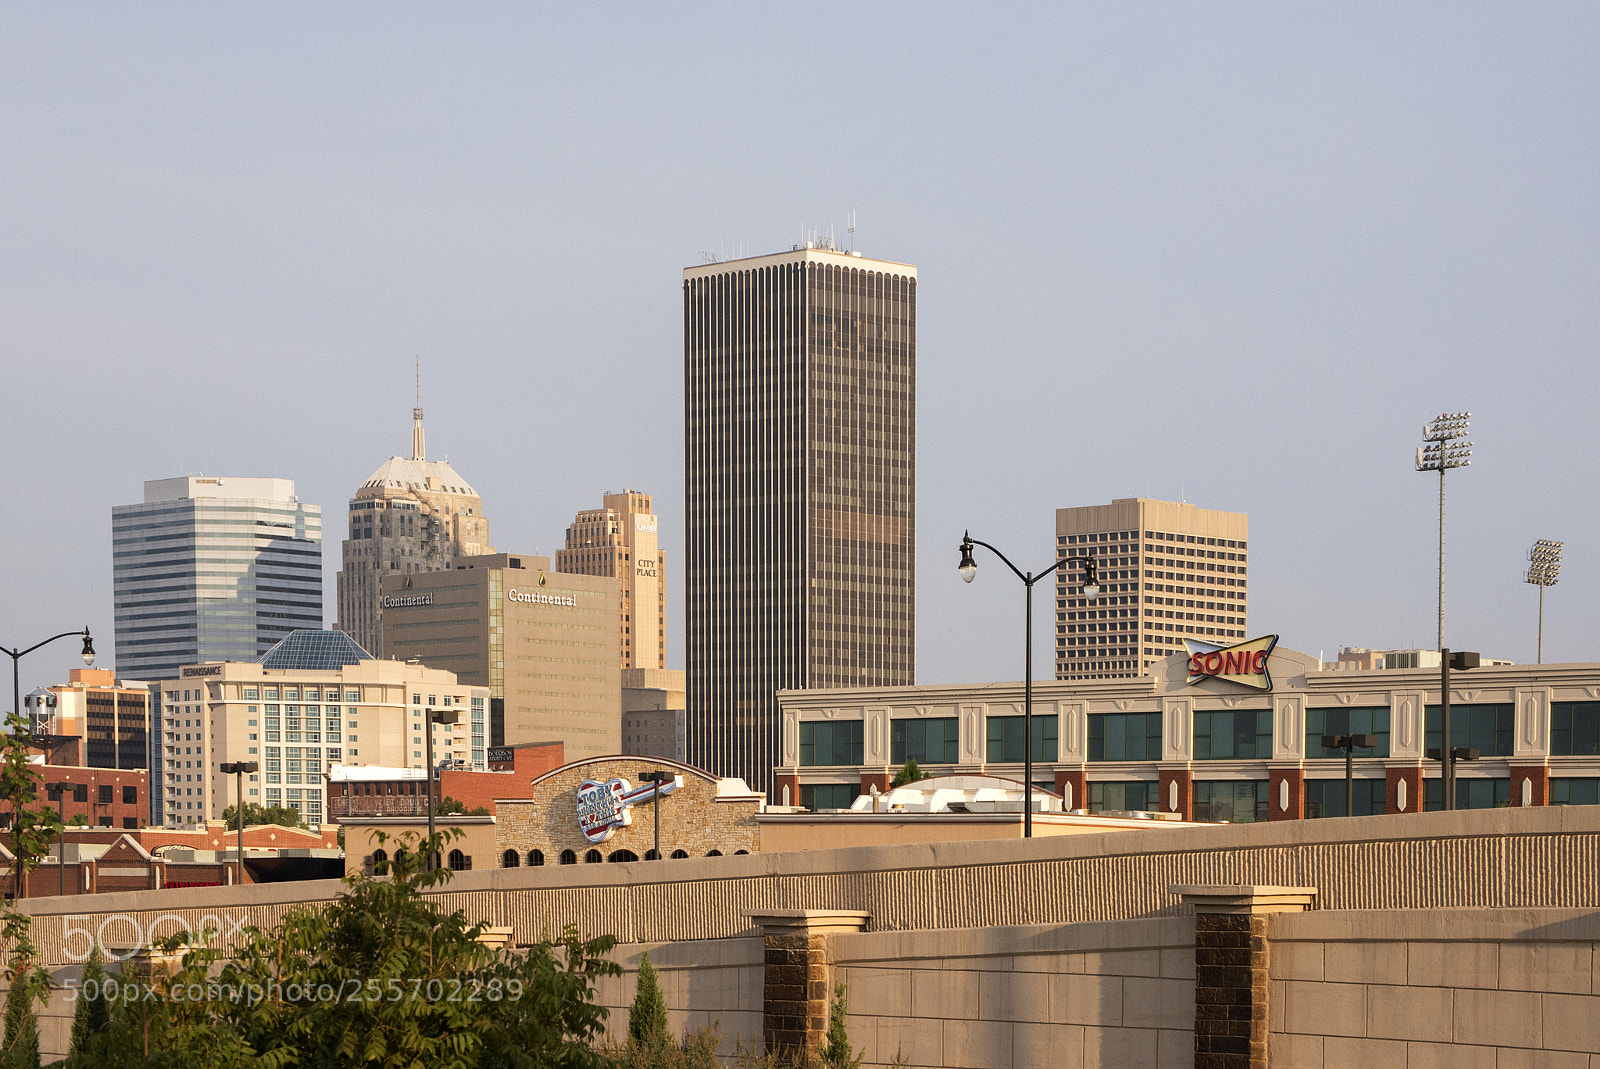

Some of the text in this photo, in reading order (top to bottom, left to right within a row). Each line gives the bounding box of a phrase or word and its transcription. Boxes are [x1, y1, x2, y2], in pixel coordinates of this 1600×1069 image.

[636, 524, 657, 532] UMB
[638, 559, 656, 568] CITY
[636, 568, 657, 578] PLACE
[383, 592, 434, 608] Continental
[507, 588, 577, 607] Continental
[183, 666, 222, 677] RENAISSANCE
[1189, 649, 1269, 677] SONIC
[581, 785, 612, 805] TOBY
[583, 797, 615, 816] KEITH'S
[585, 806, 615, 824] I THIS
